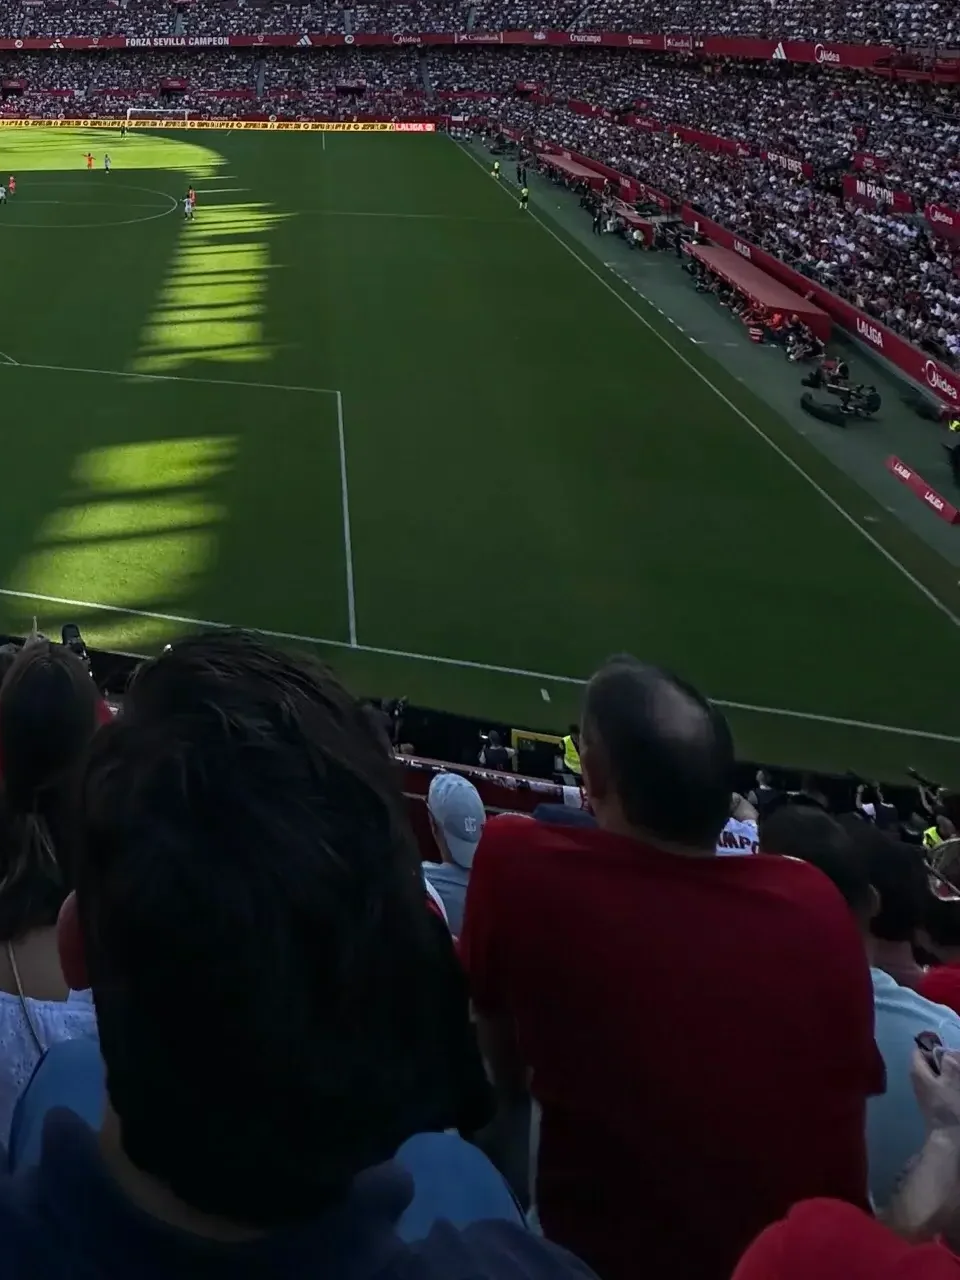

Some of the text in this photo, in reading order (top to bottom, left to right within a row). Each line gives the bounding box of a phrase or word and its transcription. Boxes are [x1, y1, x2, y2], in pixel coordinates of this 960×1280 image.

[125, 38, 151, 47] FORZA
[153, 37, 186, 46] SEVILLA
[817, 46, 840, 63] Midea
[856, 317, 883, 348] LALIGA
[928, 363, 957, 400] Midea
